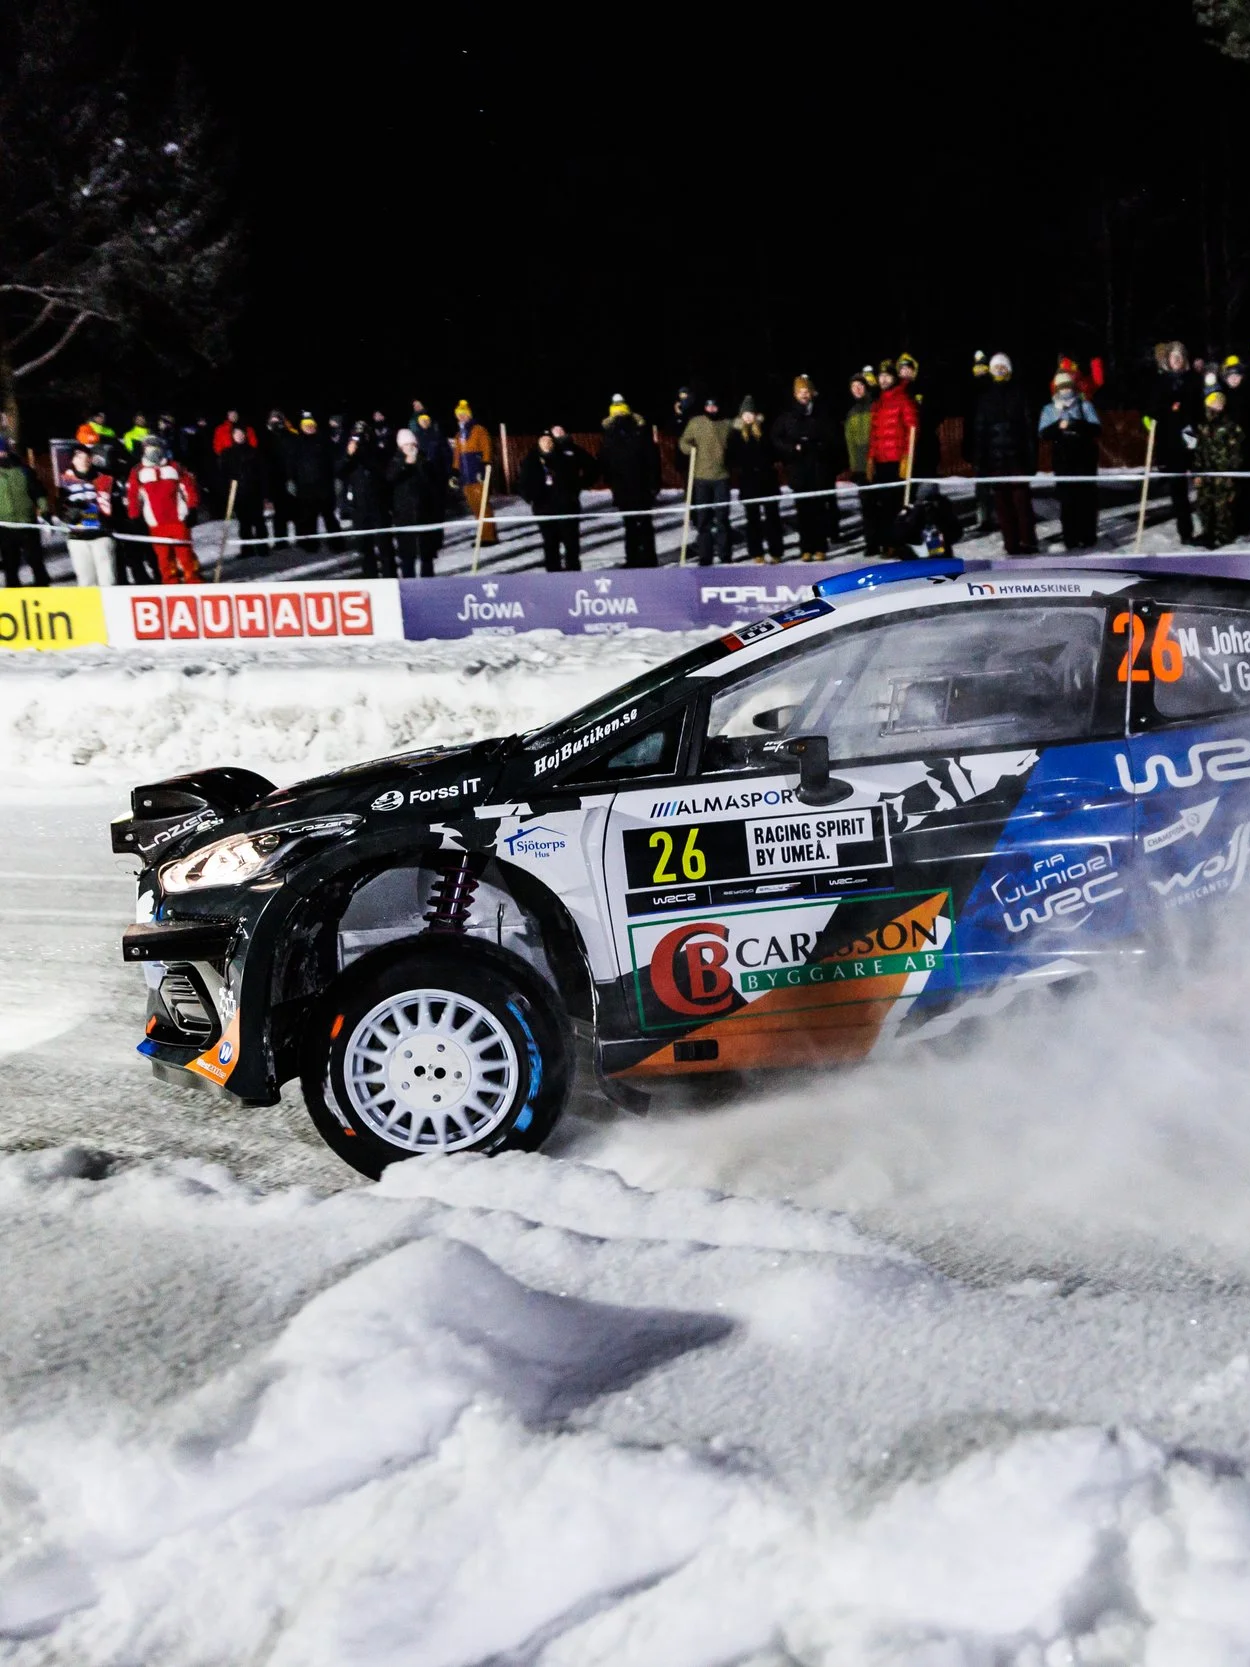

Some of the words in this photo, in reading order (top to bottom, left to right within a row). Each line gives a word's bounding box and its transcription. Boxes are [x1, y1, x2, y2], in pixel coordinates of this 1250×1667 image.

[568, 589, 639, 617] STOWA
[999, 584, 1081, 594] HYRMASKINER
[133, 595, 370, 634] BAUHAUS
[457, 593, 525, 621] STOWA
[1113, 612, 1185, 684] 26
[1178, 627, 1201, 658] M
[1219, 663, 1231, 693] J
[533, 707, 638, 777] HojButiken.se
[409, 784, 459, 804] Forss
[463, 778, 482, 795] IT
[676, 789, 797, 816] ALMASPOR
[138, 808, 215, 852] LAZER
[288, 820, 353, 834] LAZER
[754, 821, 811, 845] RACING
[816, 817, 866, 839] SPIRIT
[1147, 824, 1186, 848] CHAMPION
[516, 839, 566, 854] Sjötorps
[649, 828, 707, 884] 26
[756, 848, 775, 867] BY
[781, 840, 831, 864] UMEÅ.
[1033, 854, 1065, 873] FIA
[1004, 856, 1107, 903] JUNIOR
[652, 893, 697, 905] WRC2
[1003, 871, 1124, 933] WRC
[747, 960, 883, 990] BYGGARE
[904, 954, 937, 970] AB
